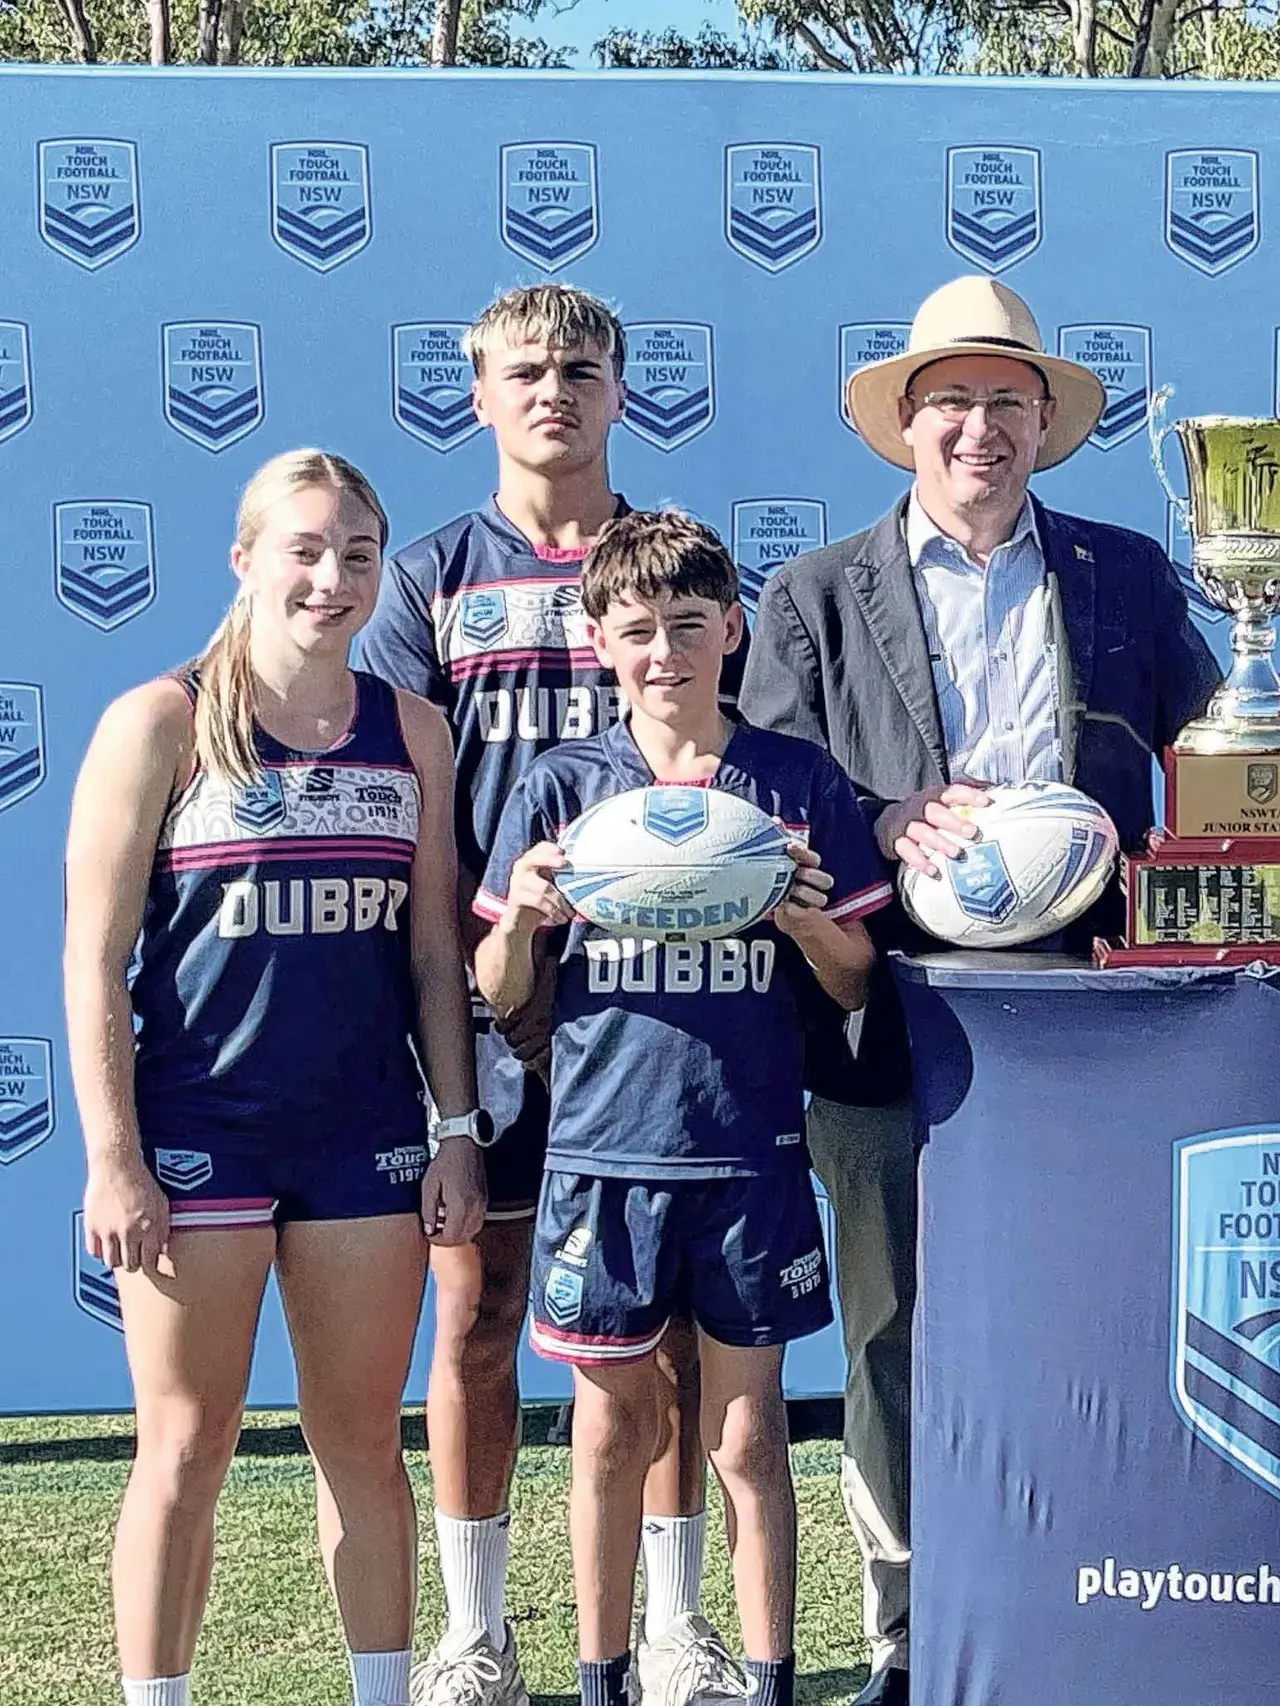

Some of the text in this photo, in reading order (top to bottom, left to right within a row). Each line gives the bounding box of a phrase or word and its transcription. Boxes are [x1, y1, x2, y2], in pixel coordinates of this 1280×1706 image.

[67, 156, 107, 166] TOUCH
[299, 158, 338, 168] TOUCH
[529, 159, 567, 169] TOUCH
[754, 161, 791, 170] TOUCH
[58, 167, 120, 178] FOOTBALL
[975, 163, 1012, 173] TOUCH
[1193, 166, 1230, 175] TOUCH
[290, 170, 350, 180] FOOTBALL
[519, 170, 579, 181] FOOTBALL
[744, 171, 803, 182] FOOTBALL
[965, 174, 1023, 184] FOOTBALL
[1184, 176, 1242, 187] FOOTBALL
[68, 184, 110, 199] NSW
[300, 186, 341, 202] NSW
[529, 187, 569, 202] NSW
[754, 187, 793, 202] NSW
[975, 190, 1014, 204] NSW
[1193, 192, 1232, 207] NSW
[191, 339, 230, 349] TOUCH
[420, 340, 459, 350] TOUCH
[646, 339, 684, 349] TOUCH
[867, 340, 904, 350] TOUCH
[1086, 341, 1123, 350] TOUCH
[182, 350, 244, 361] FOOTBALL
[637, 350, 697, 361] FOOTBALL
[1076, 351, 1134, 362] FOOTBALL
[192, 367, 233, 382] NSW
[421, 368, 462, 383] NSW
[646, 367, 686, 382] NSW
[1095, 367, 1124, 382] SW
[83, 518, 122, 528] TOUCH
[760, 517, 797, 526] TOUCH
[74, 529, 135, 540] FOOTBALL
[751, 527, 809, 538] FOOTBALL
[84, 546, 125, 561] NSW
[760, 543, 799, 558] NSW
[1201, 823, 1252, 834] JUNIOR
[594, 896, 750, 930] STEEDEN
[584, 938, 776, 993] DUBBO
[0, 1082, 25, 1097] SW
[375, 1151, 427, 1169] Touc
[398, 1168, 424, 1183] 197
